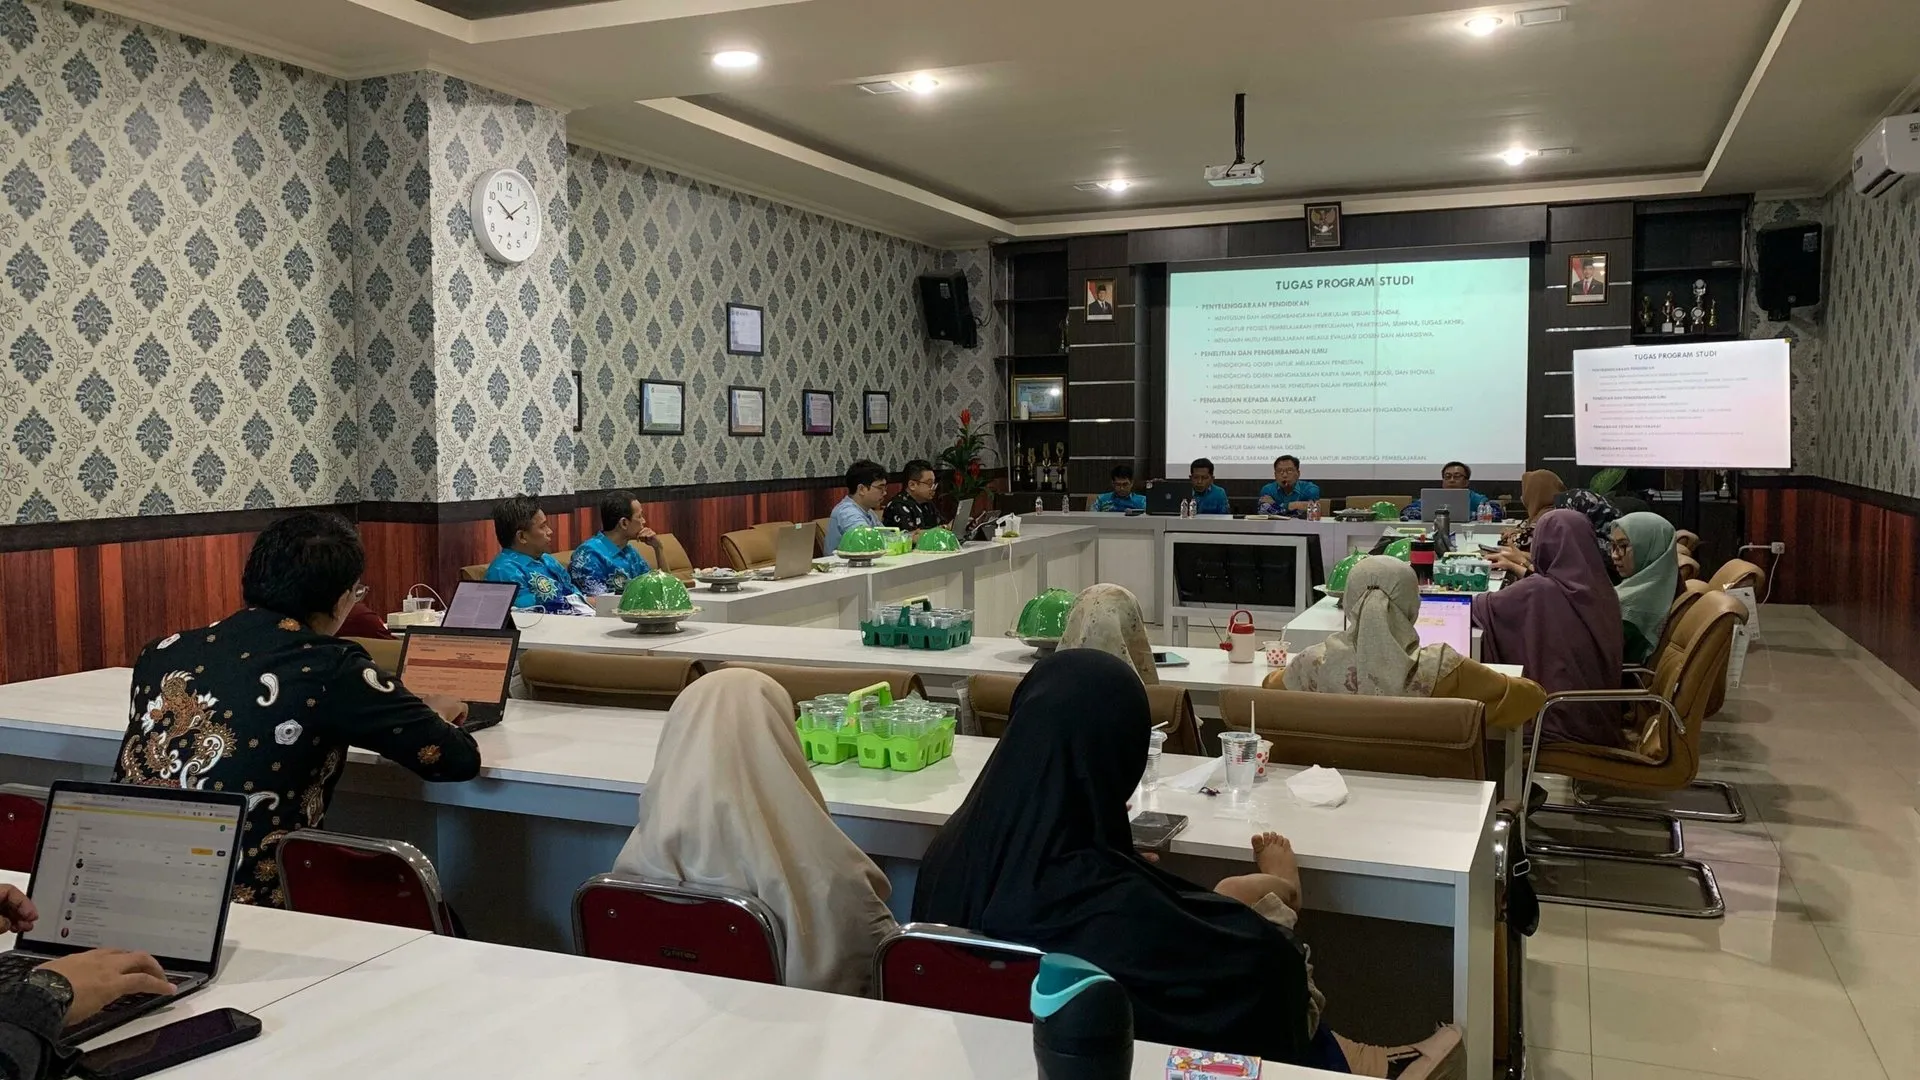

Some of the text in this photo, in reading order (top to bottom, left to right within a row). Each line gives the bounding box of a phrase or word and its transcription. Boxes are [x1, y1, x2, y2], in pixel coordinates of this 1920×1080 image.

[497, 182, 502, 192] 11
[506, 181, 512, 191] 12
[489, 191, 496, 200] 10
[523, 201, 527, 210] 2
[487, 206, 492, 215] 9
[526, 216, 530, 225] 3
[490, 222, 495, 232] 8
[498, 235, 503, 244] 7
[516, 240, 520, 248] 5
[506, 242, 511, 250] 6
[1276, 276, 1414, 290] TUGAS PROGRAM STUDI
[1202, 300, 1309, 310] PENYELENGGARAAN PENDIDIKAN
